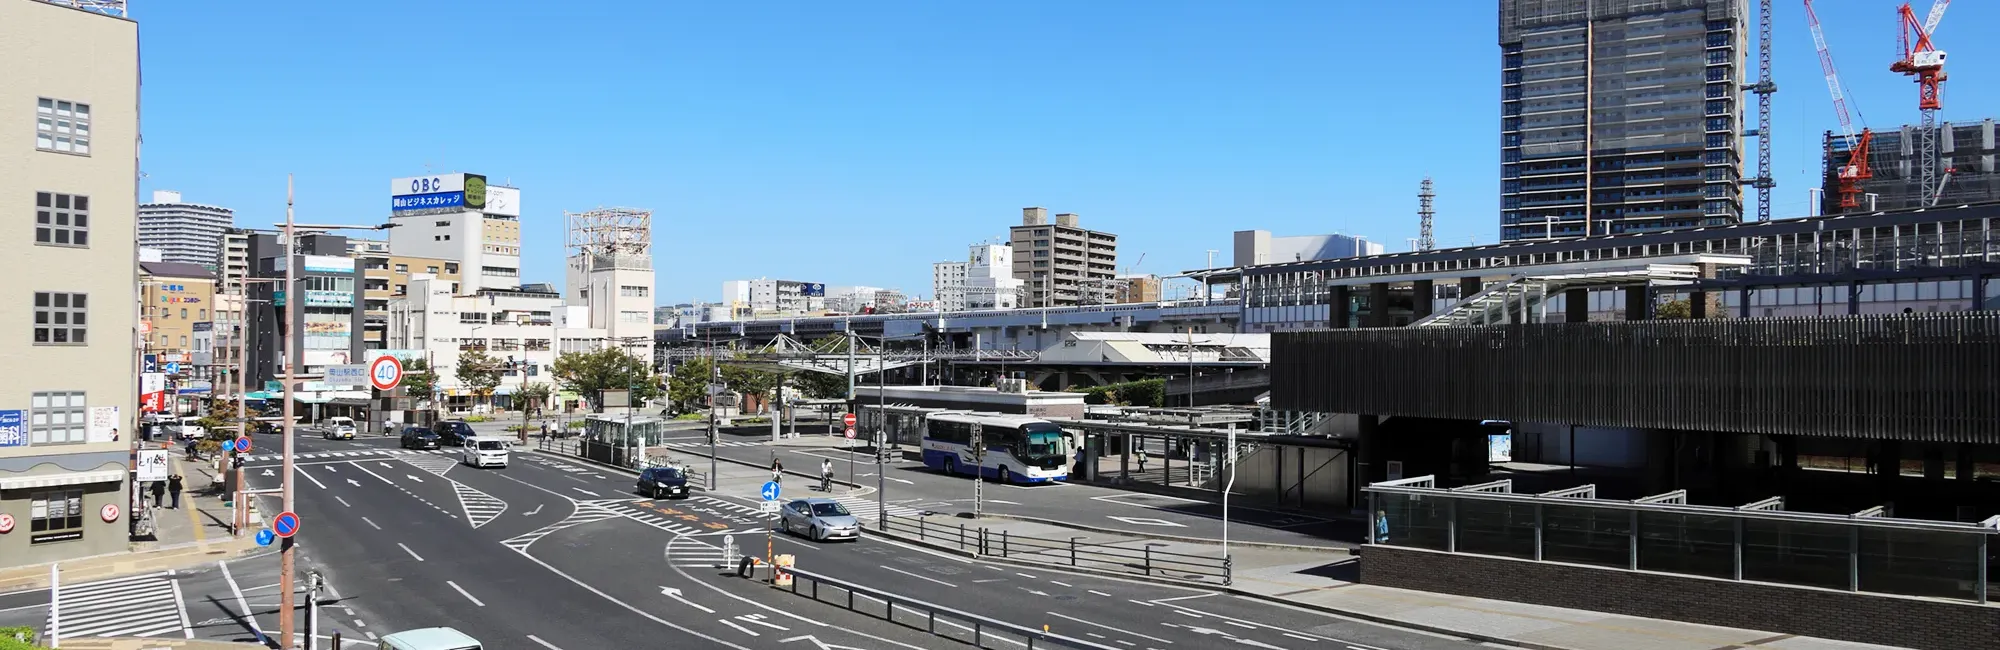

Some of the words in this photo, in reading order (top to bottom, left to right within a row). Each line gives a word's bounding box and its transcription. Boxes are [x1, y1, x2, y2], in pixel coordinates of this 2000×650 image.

[412, 178, 440, 193] OBC
[393, 194, 460, 208] 岡山ビジネスカレッジ
[329, 368, 365, 376] 岡山駅西口
[377, 365, 395, 379] 40
